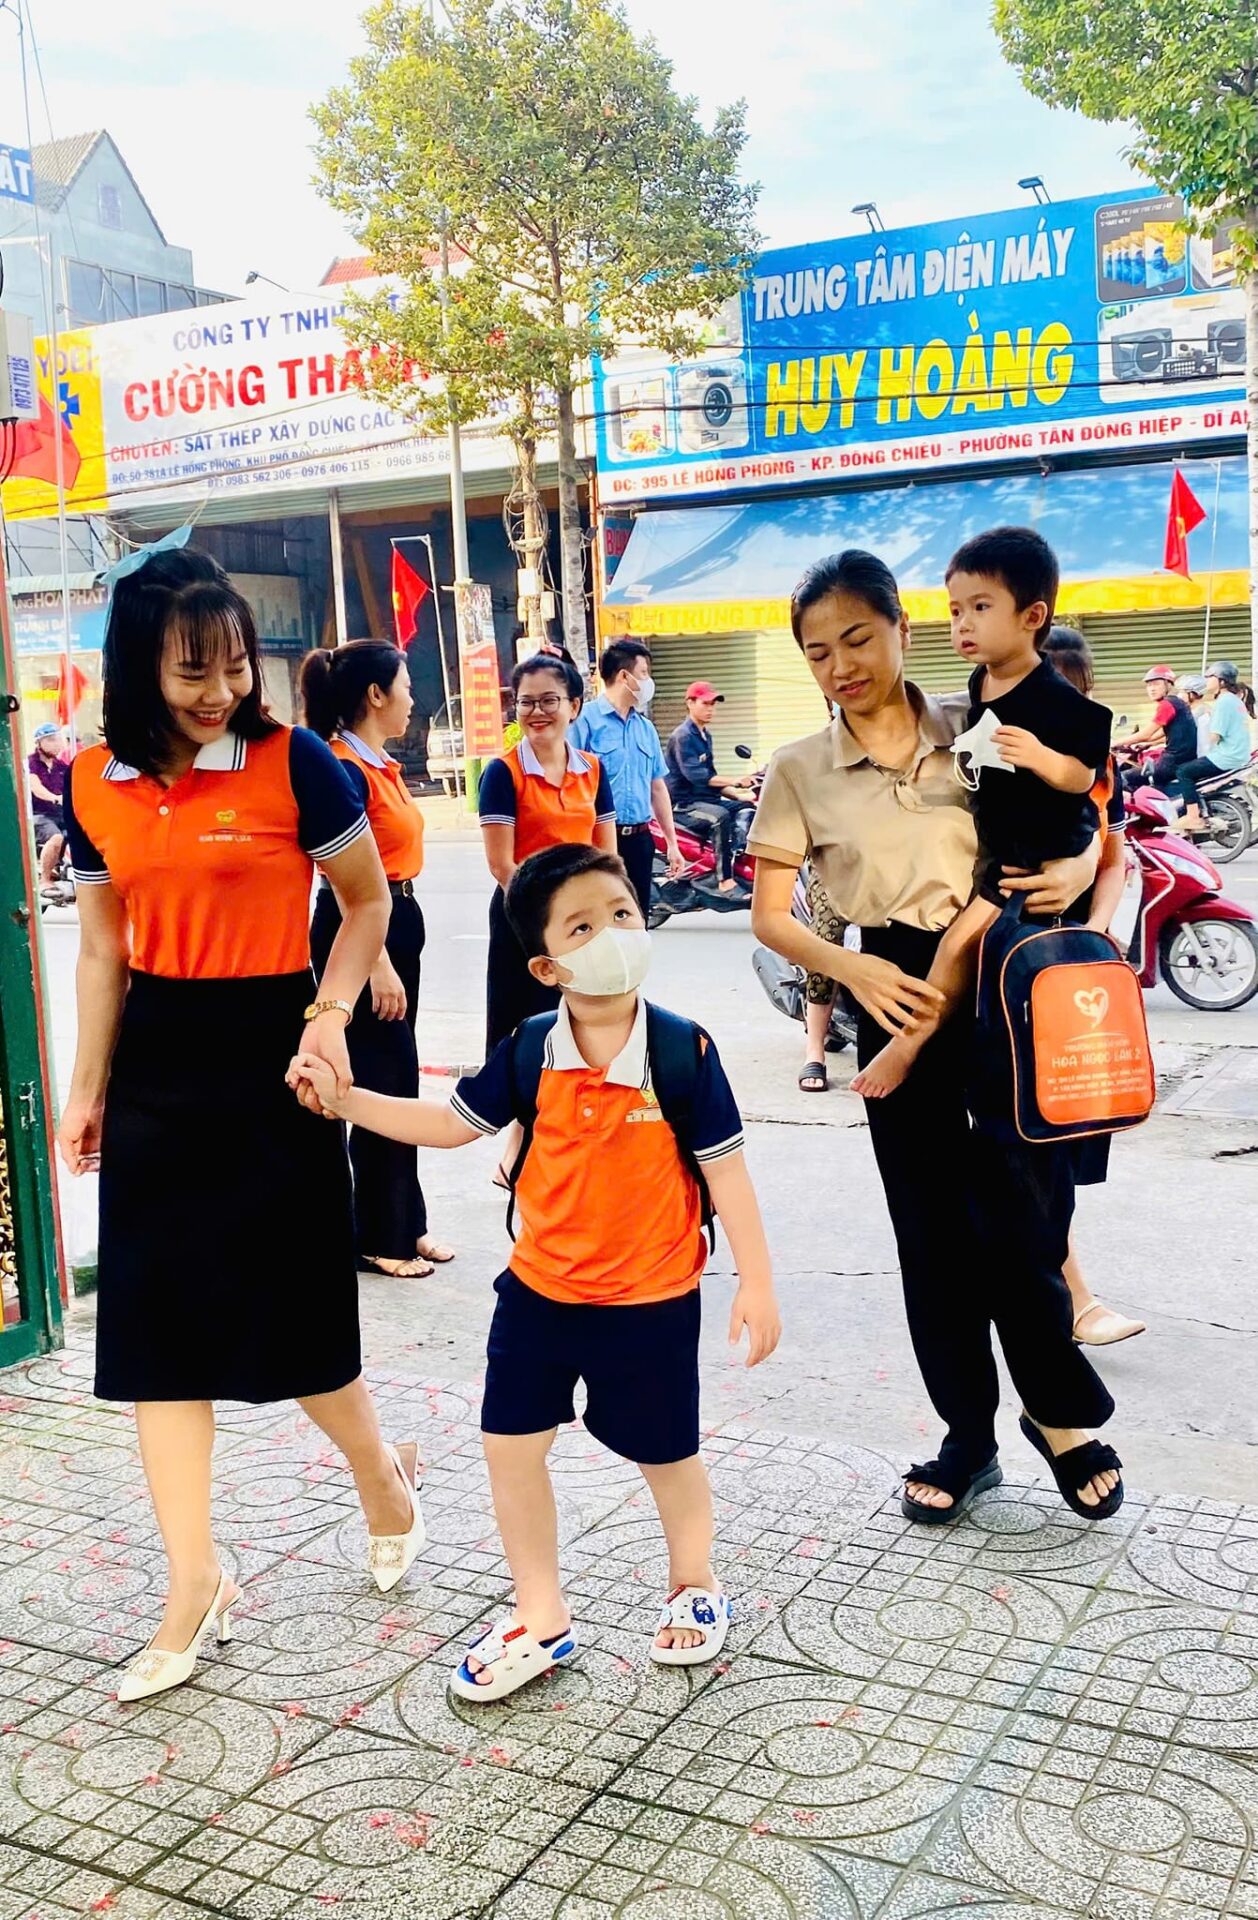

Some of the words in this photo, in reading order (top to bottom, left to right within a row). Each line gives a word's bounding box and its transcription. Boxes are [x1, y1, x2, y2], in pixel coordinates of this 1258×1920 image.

[753, 264, 847, 322] TRUNG
[855, 245, 916, 307] TÂM
[922, 231, 996, 306] ĐIỆN
[1000, 217, 1075, 285] MÁY
[173, 323, 234, 351] CÔNG
[240, 316, 271, 341] TY
[124, 362, 266, 422] CƯỜNG
[764, 350, 867, 438] HUY
[876, 310, 1075, 424] HOÀNG
[110, 437, 180, 462] CHUYÊN:
[269, 419, 301, 442] XÂY
[308, 414, 355, 440] DỰNG
[360, 407, 395, 431] CÁC
[642, 475, 669, 490] 395
[741, 460, 795, 479] PHONG
[812, 456, 835, 471] KP.
[840, 448, 886, 467] ĐÔNG
[960, 432, 1033, 454] PHƯỜNG
[1038, 427, 1074, 445] TÂN
[1080, 421, 1132, 441] ĐÔNG
[1139, 415, 1182, 436] HIỆP
[1203, 409, 1223, 428] DĨ
[301, 466, 326, 477] 0976
[329, 463, 348, 475] 406
